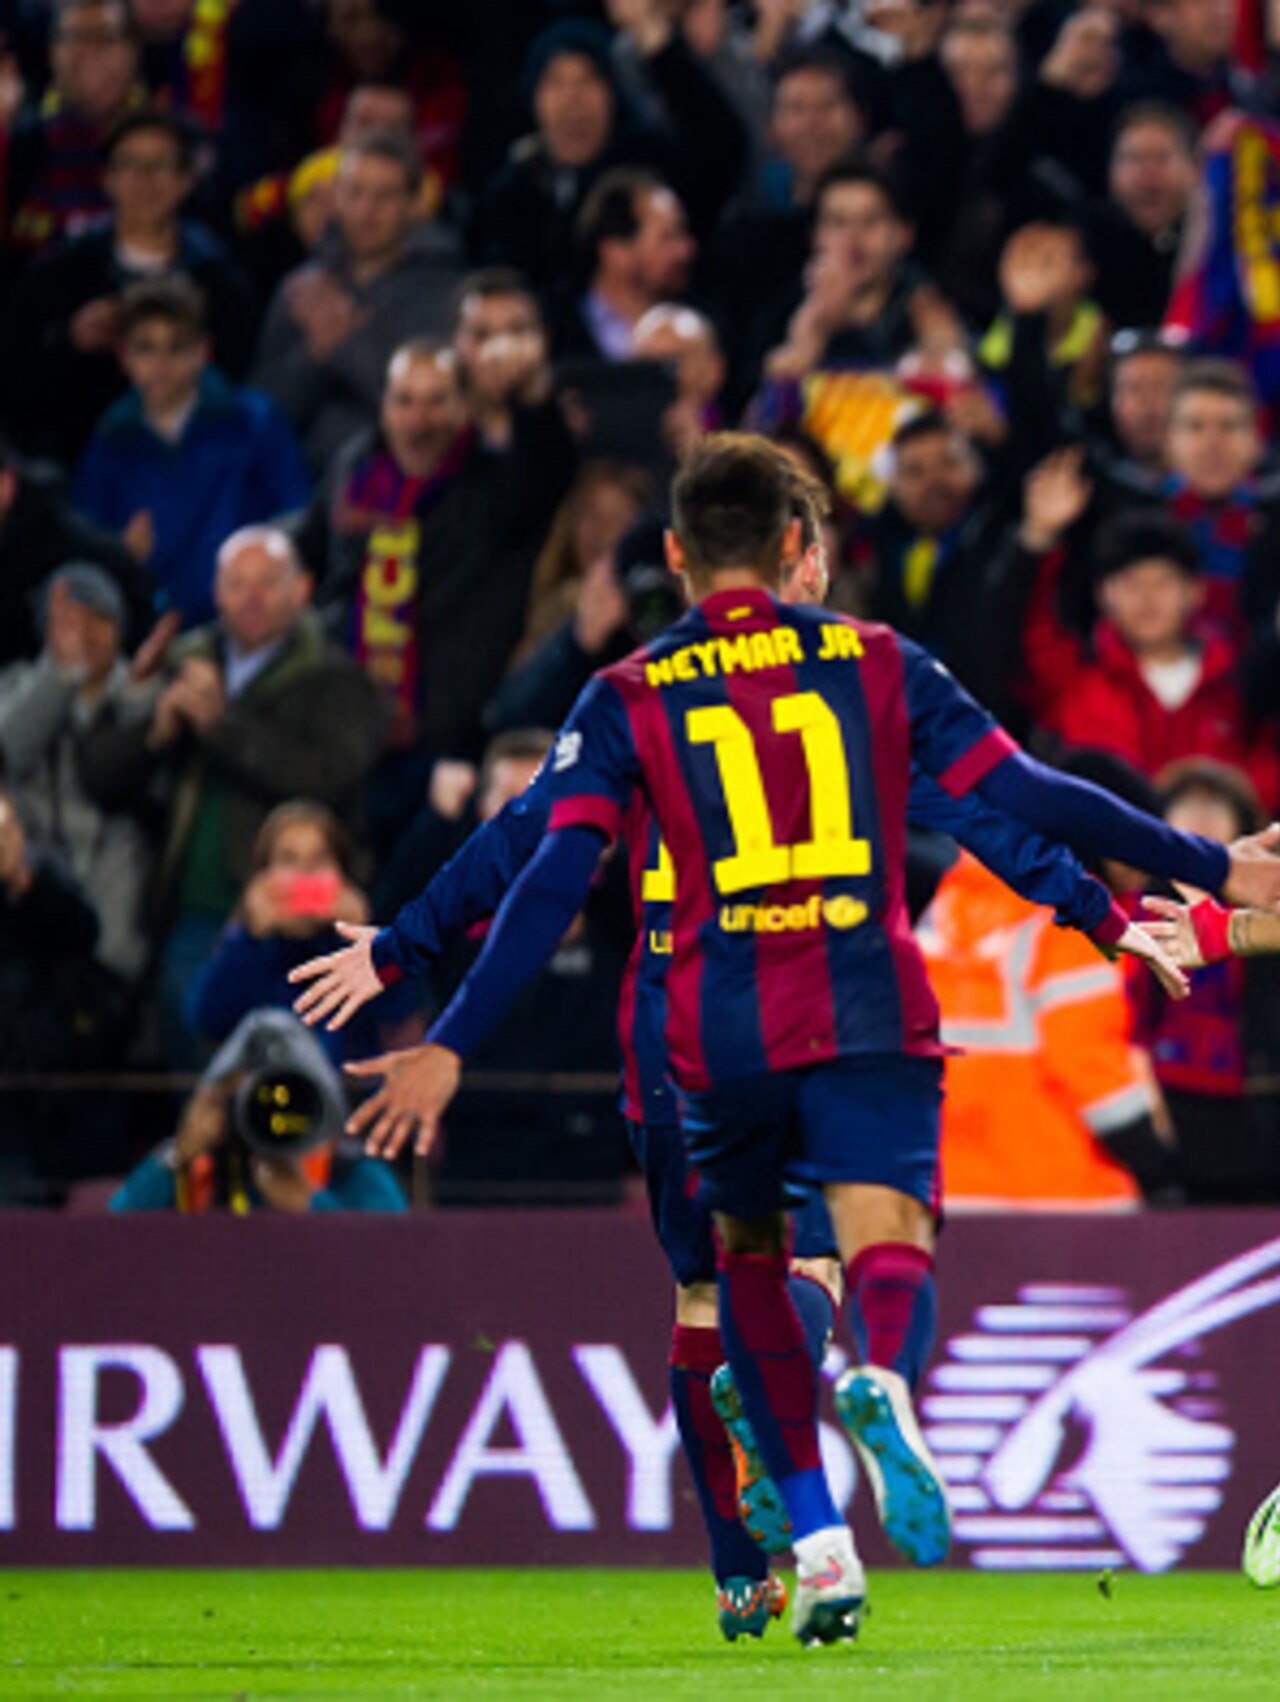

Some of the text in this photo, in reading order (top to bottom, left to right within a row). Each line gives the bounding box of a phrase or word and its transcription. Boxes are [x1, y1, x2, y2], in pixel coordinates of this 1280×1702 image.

[645, 624, 864, 686] NEYMAR JR
[685, 691, 871, 894] 11
[719, 896, 822, 932] unicef
